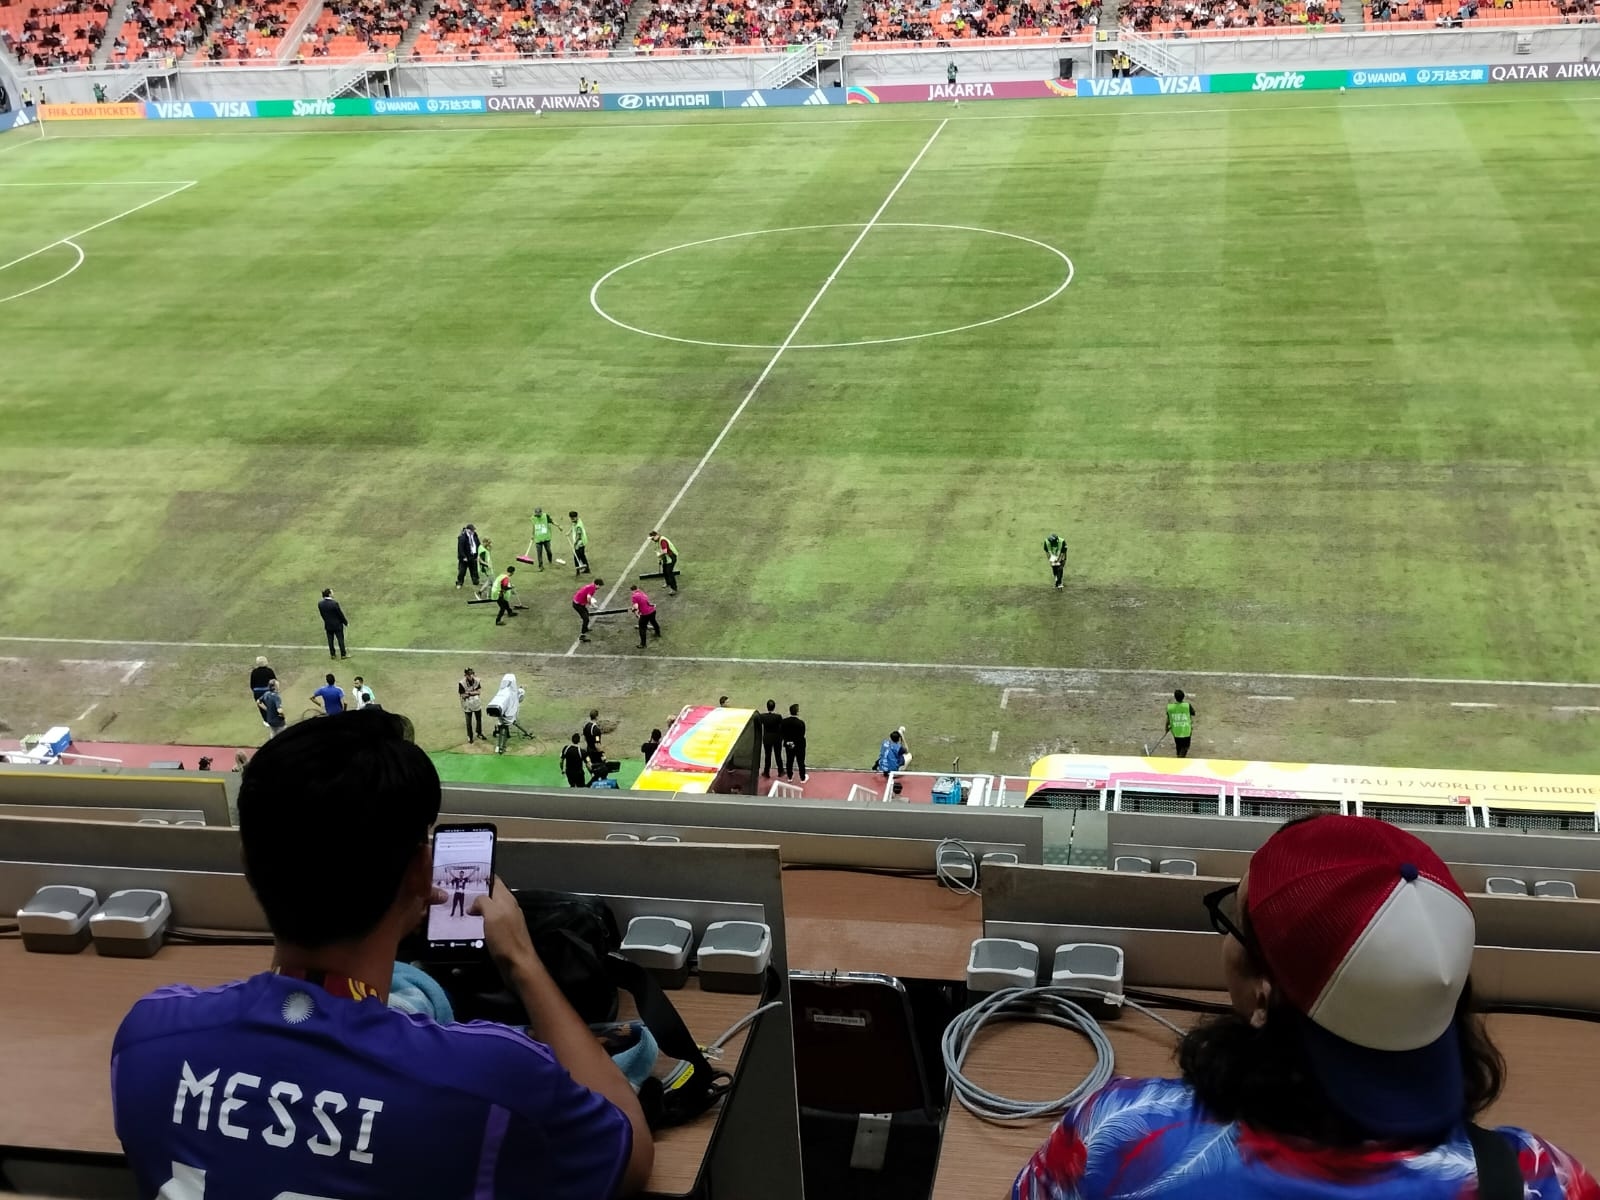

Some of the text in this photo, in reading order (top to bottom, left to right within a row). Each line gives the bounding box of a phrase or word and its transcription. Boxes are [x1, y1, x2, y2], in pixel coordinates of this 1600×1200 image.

[1367, 72, 1407, 83] WANDA
[1491, 63, 1600, 81] QATAR AIRW
[1087, 78, 1134, 96] VISA
[1154, 76, 1202, 94] VISA
[1251, 72, 1306, 91] Sprite
[927, 83, 994, 100] JAKARTA
[292, 98, 336, 117] Sprite
[386, 101, 420, 112] WANDA
[488, 95, 600, 111] QATAR AIRWAYS
[645, 94, 710, 107] HYUNDAI
[48, 106, 137, 118] FIFA.COM/TICKETS
[153, 103, 195, 118] VISA
[209, 102, 251, 118] VISA
[1419, 781, 1487, 791] WORLD
[1493, 784, 1530, 793] CUP
[173, 1060, 384, 1165] MESSI
